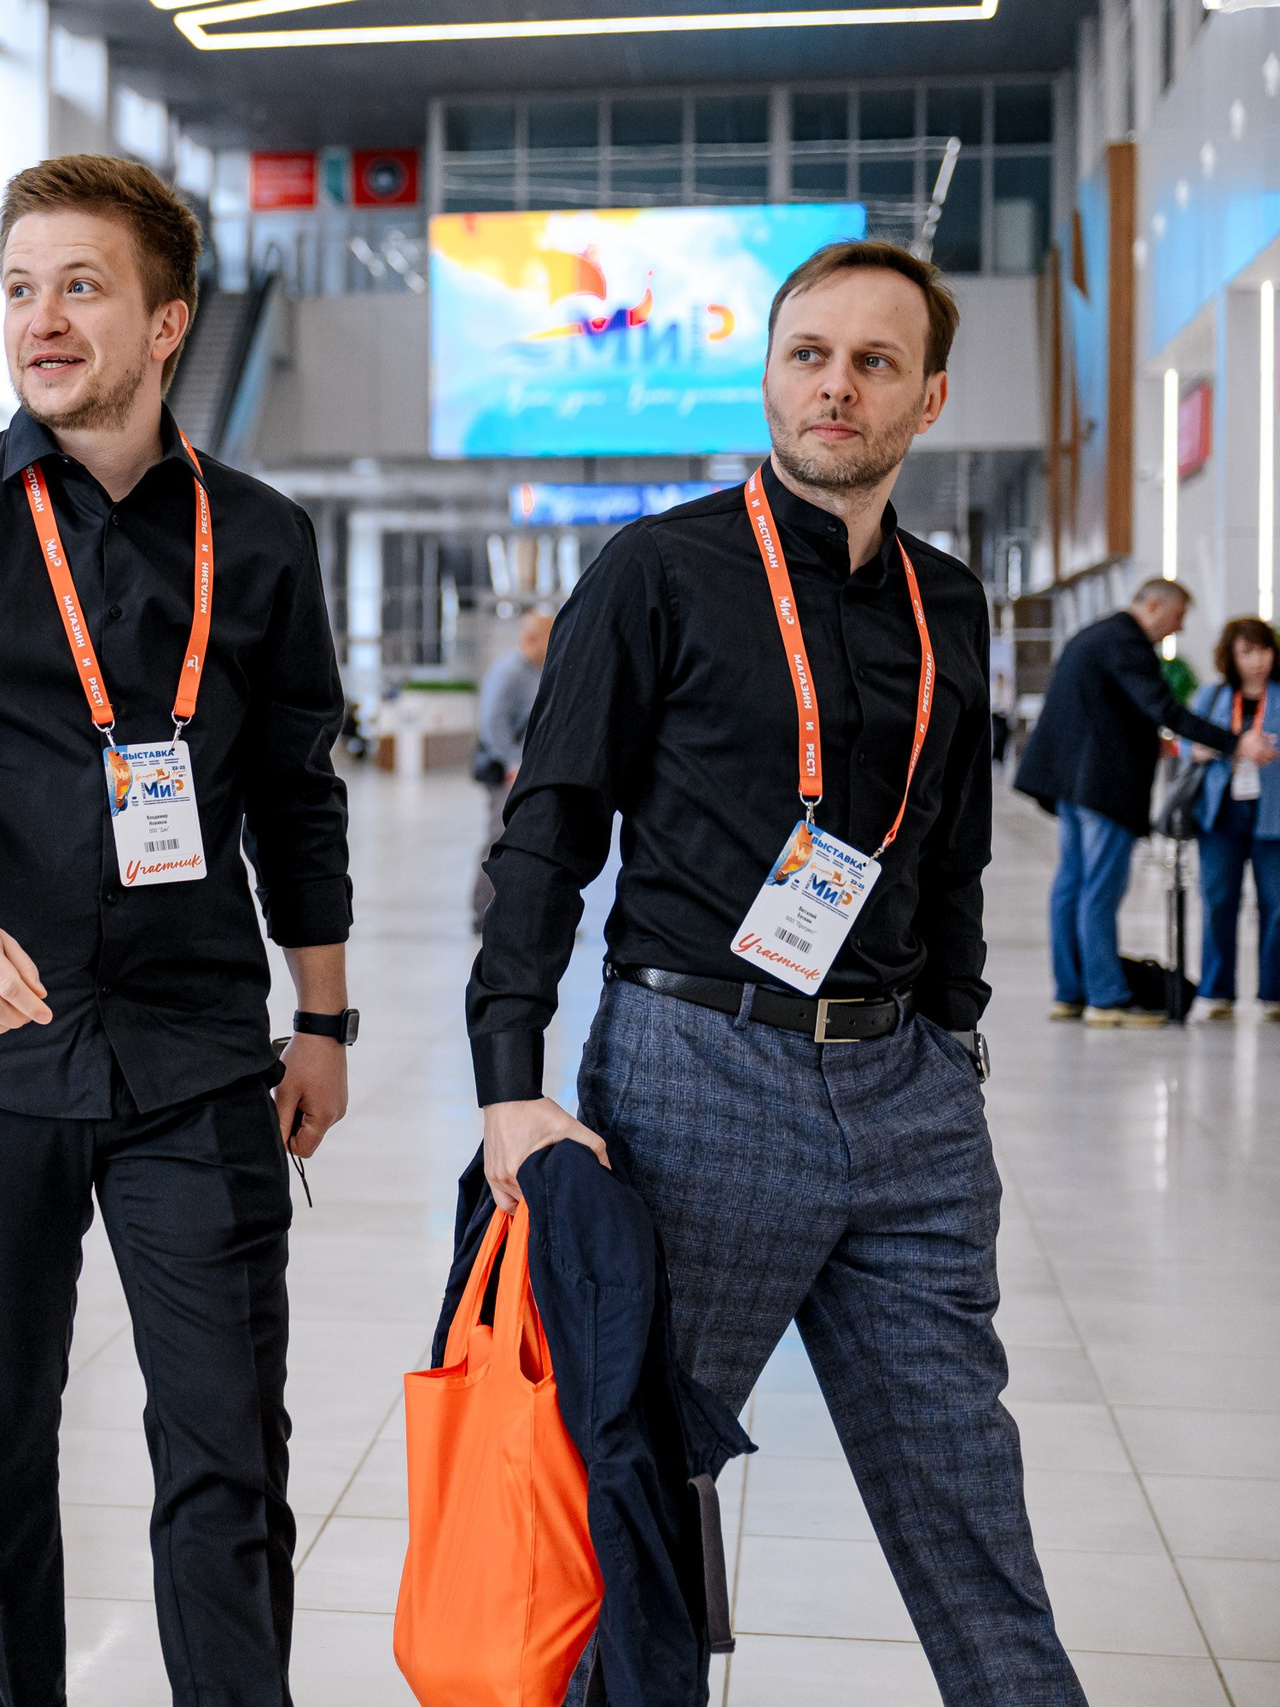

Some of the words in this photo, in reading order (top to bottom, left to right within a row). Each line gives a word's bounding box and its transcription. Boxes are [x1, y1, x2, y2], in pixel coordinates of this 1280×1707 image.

[751, 498, 761, 508] И
[201, 544, 209, 552] И
[756, 514, 779, 569] РЕСТОРАН
[200, 562, 209, 614] МАГАЗИН
[63, 595, 85, 648] МАГАЗИН
[82, 657, 92, 667] И
[88, 676, 104, 706] РЕСТ
[793, 653, 813, 710] МАГАЗИН
[922, 652, 932, 713] РЕСТОРАН
[805, 721, 814, 731] И
[122, 749, 175, 761] ВЫСТАВКА
[805, 743, 816, 777] РЕСТ
[125, 854, 203, 886] Участник
[811, 836, 863, 871] ВЫСТАВКА
[732, 933, 821, 981] Участник
